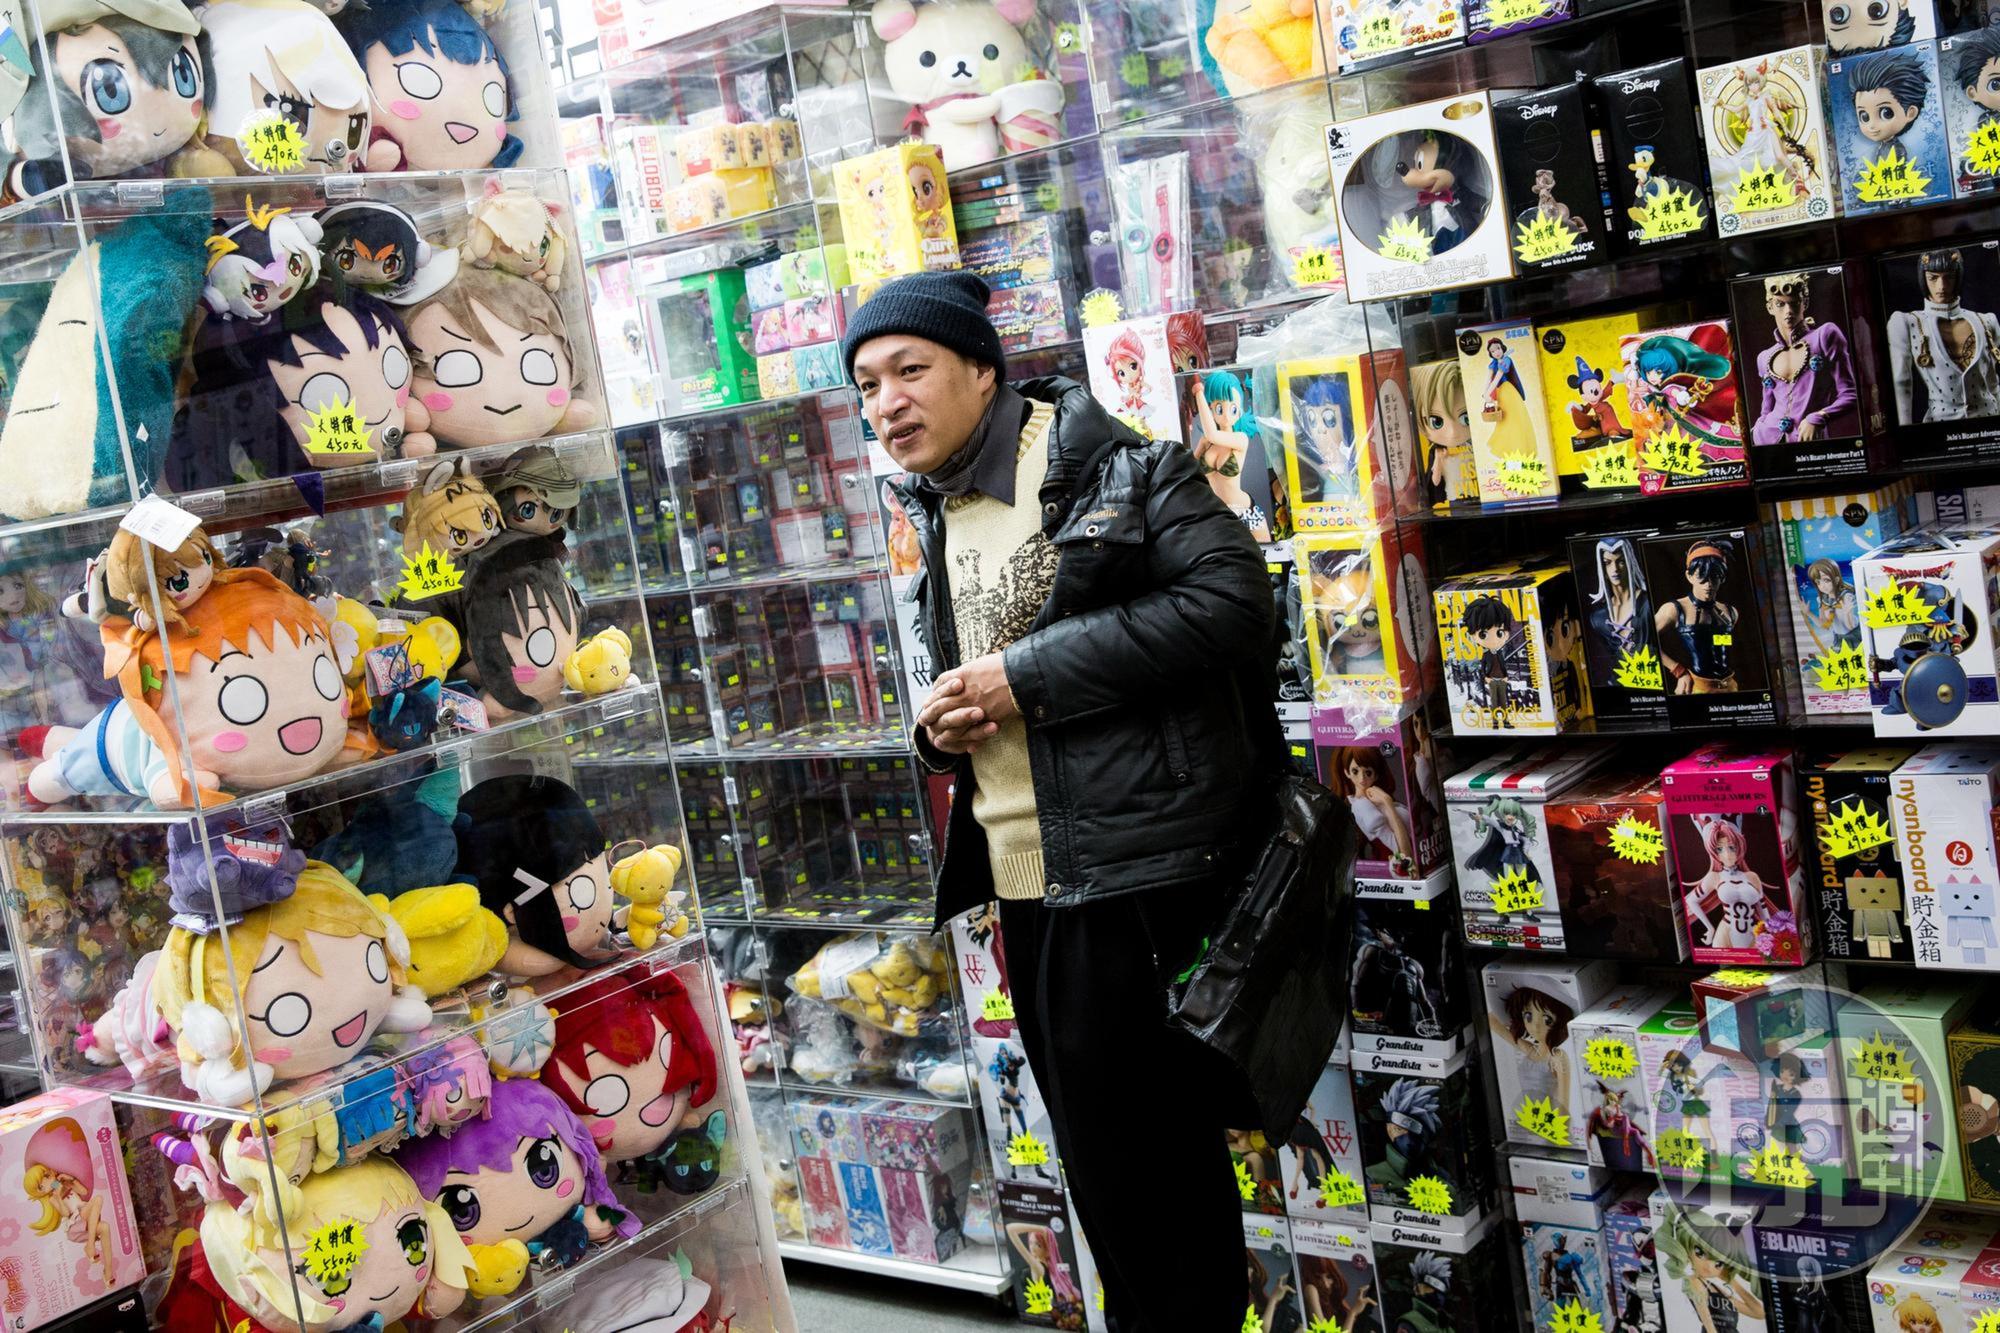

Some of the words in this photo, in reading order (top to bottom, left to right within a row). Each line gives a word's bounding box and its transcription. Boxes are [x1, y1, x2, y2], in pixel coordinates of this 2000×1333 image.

[1363, 17, 1391, 36] 大特價
[1366, 35, 1397, 49] 490元
[1618, 78, 1661, 96] Disney
[1517, 103, 1558, 121] Disney
[253, 124, 290, 144] 大特價
[263, 144, 298, 164] 490元
[643, 156, 664, 209] ROBOT
[1738, 172, 1777, 194] 大特價
[1868, 164, 1908, 186] 大特價
[1746, 192, 1783, 208] 490元
[1874, 185, 1915, 199] 450元
[1649, 196, 1687, 221] 大特價
[1525, 222, 1558, 247] 大特價
[1658, 218, 1693, 234] 450元
[1505, 328, 1530, 340] SEGA
[318, 414, 357, 435] 大特價
[326, 438, 363, 452] 450元
[1653, 440, 1693, 459] 大特價
[1595, 455, 1627, 473] 大特價
[1661, 455, 1694, 474] 390元
[1600, 472, 1628, 484] 490元
[413, 558, 441, 581] 特價
[421, 575, 455, 591] 450元
[1875, 593, 1906, 612] 特價
[1884, 612, 1923, 624] 450元
[1625, 660, 1658, 675] 大特價
[1826, 653, 1864, 677] 大特價
[1632, 675, 1665, 688] 450元
[1836, 673, 1868, 693] 490元
[1864, 776, 1887, 784] TAITO
[1957, 778, 1982, 787] TAITO
[1833, 814, 1871, 839] 大特價
[1896, 779, 1935, 893] nyanboard
[1355, 880, 1405, 896] Grandista
[1497, 880, 1531, 898] 大特價
[1820, 889, 1850, 957] 貯金箱
[1911, 894, 1942, 964] 貯金箱
[1375, 1037, 1425, 1053] Grandista
[1593, 1045, 1625, 1060] 大特價
[1371, 1055, 1422, 1071] Grandista
[1861, 1050, 1898, 1067] 大特價
[1866, 1064, 1905, 1080] 490元
[1531, 1106, 1556, 1127] 特價
[1662, 1136, 1695, 1151] 大特價
[1758, 1154, 1794, 1170] 大特價
[1765, 1169, 1799, 1185] 390元
[1393, 1210, 1442, 1227] Grandista
[313, 1223, 354, 1252] 大特價
[1391, 1228, 1443, 1246] Grandista
[1767, 1231, 1828, 1257] BLAME!
[322, 1251, 357, 1272] 550元
